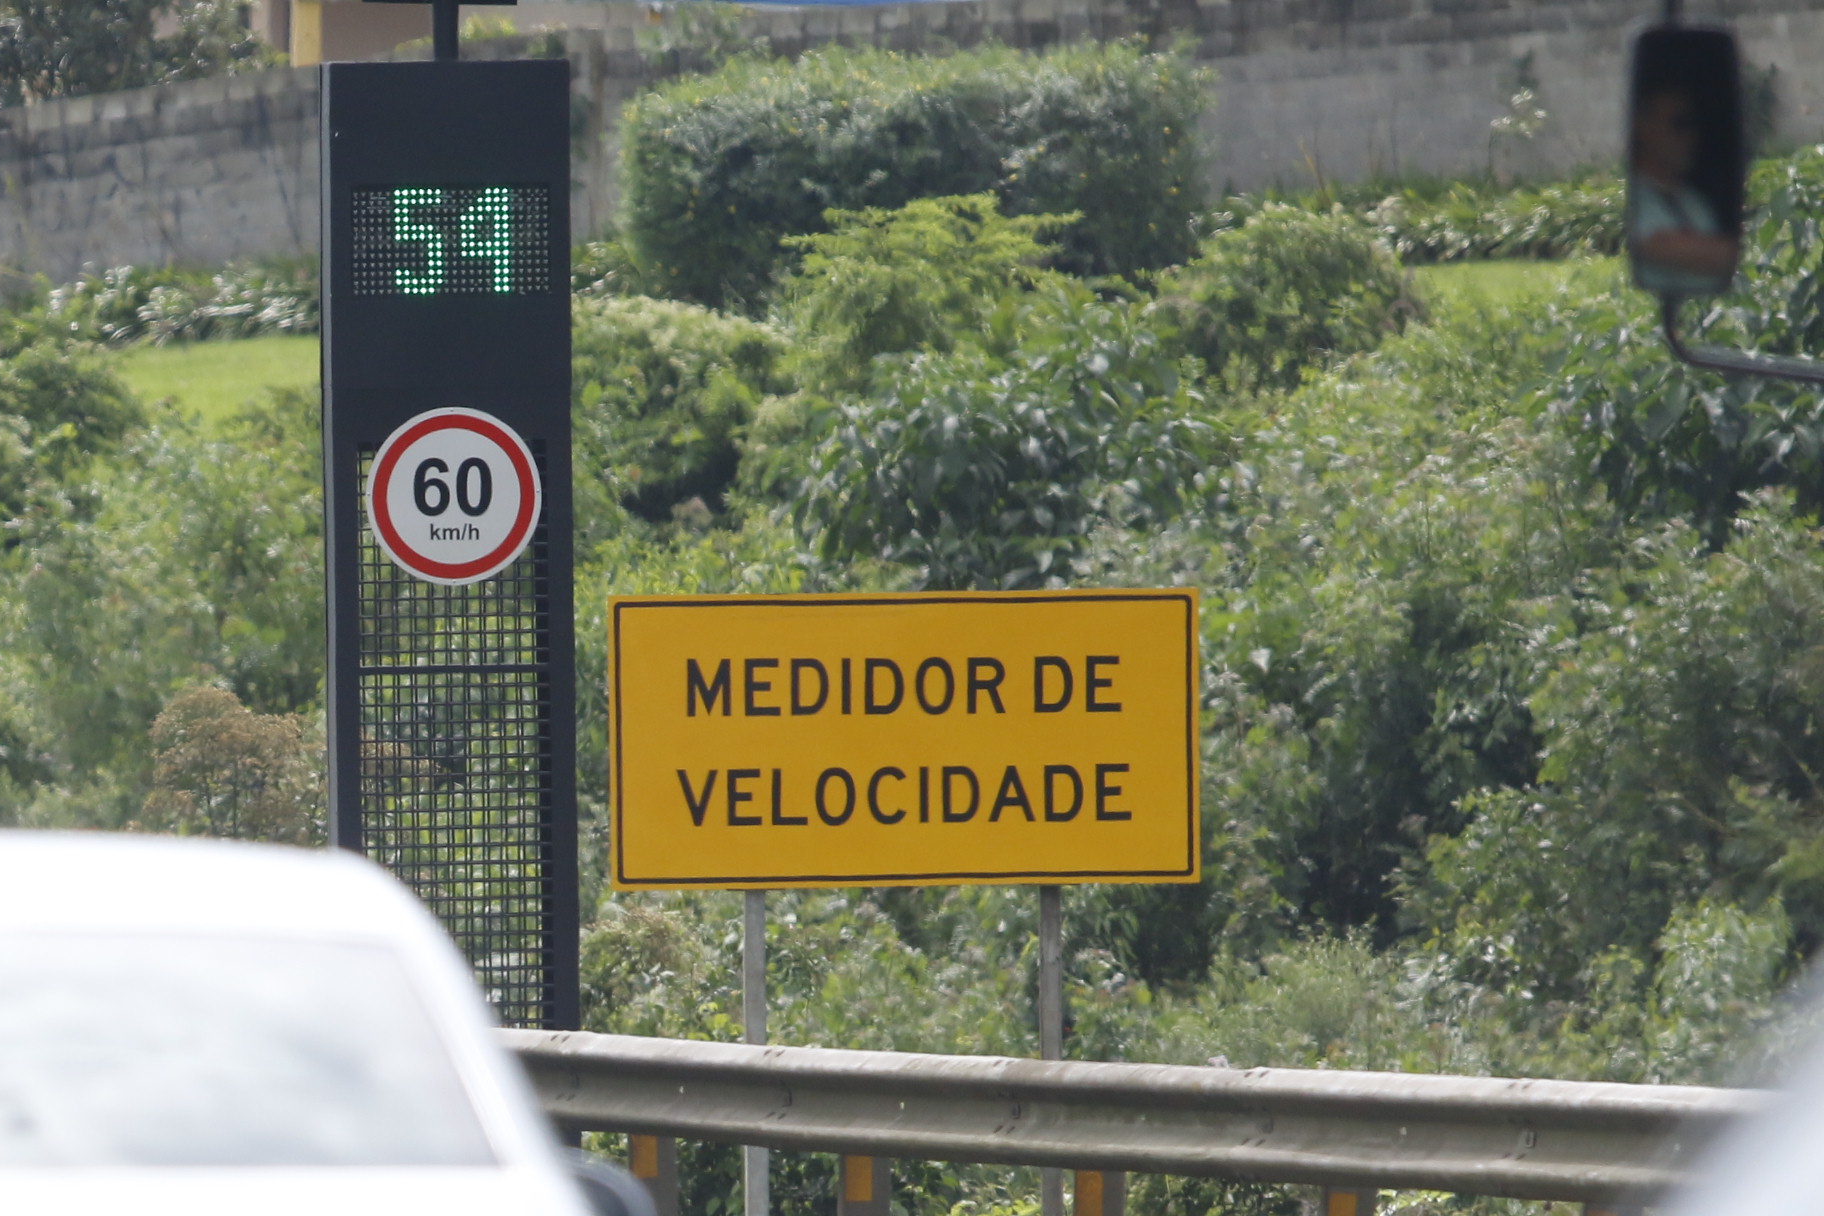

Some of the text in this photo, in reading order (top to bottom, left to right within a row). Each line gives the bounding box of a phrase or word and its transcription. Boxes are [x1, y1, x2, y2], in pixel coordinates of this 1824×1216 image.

[393, 187, 511, 295] 54
[413, 457, 493, 517] 60
[429, 523, 480, 541] km/h
[686, 655, 1123, 717] MEDIDOR DE
[676, 763, 1133, 826] VELOCIDADE
